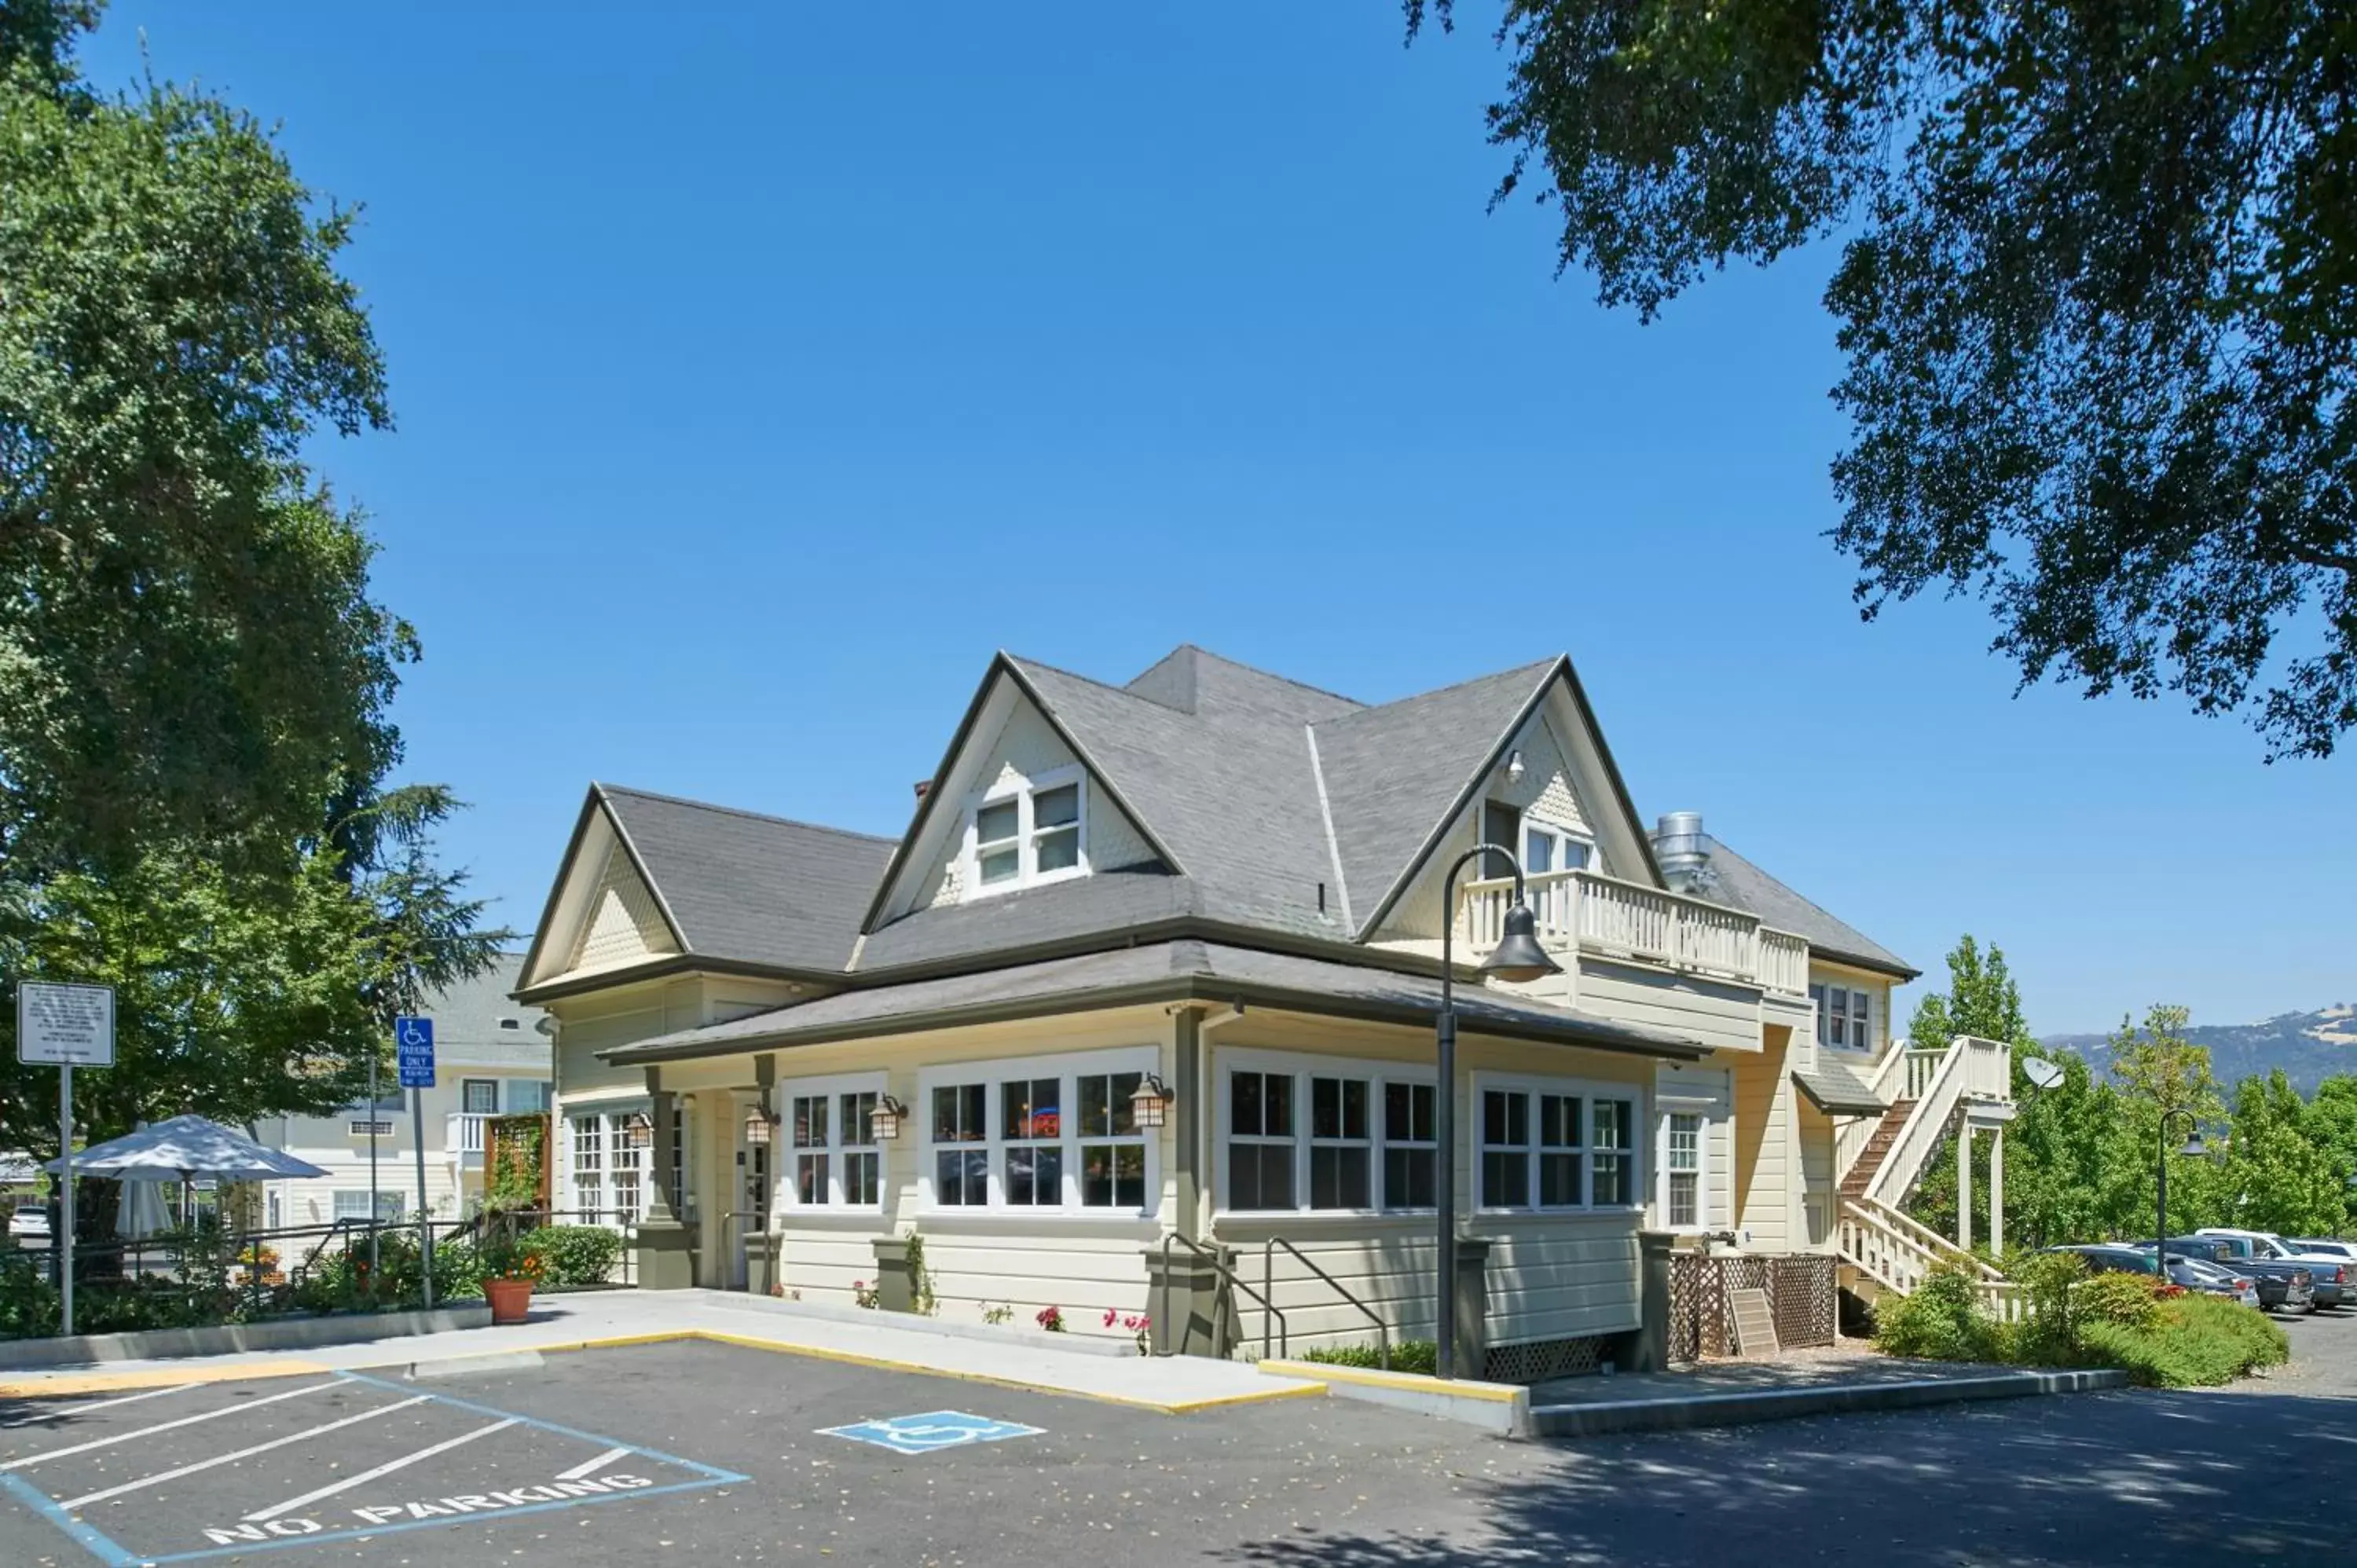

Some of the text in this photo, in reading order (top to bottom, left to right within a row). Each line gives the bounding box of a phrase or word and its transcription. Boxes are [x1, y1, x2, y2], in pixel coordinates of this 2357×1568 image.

[400, 1045, 433, 1056] PARKING
[406, 1057, 427, 1066] ONLY
[201, 1474, 654, 1545] NO PARKING
